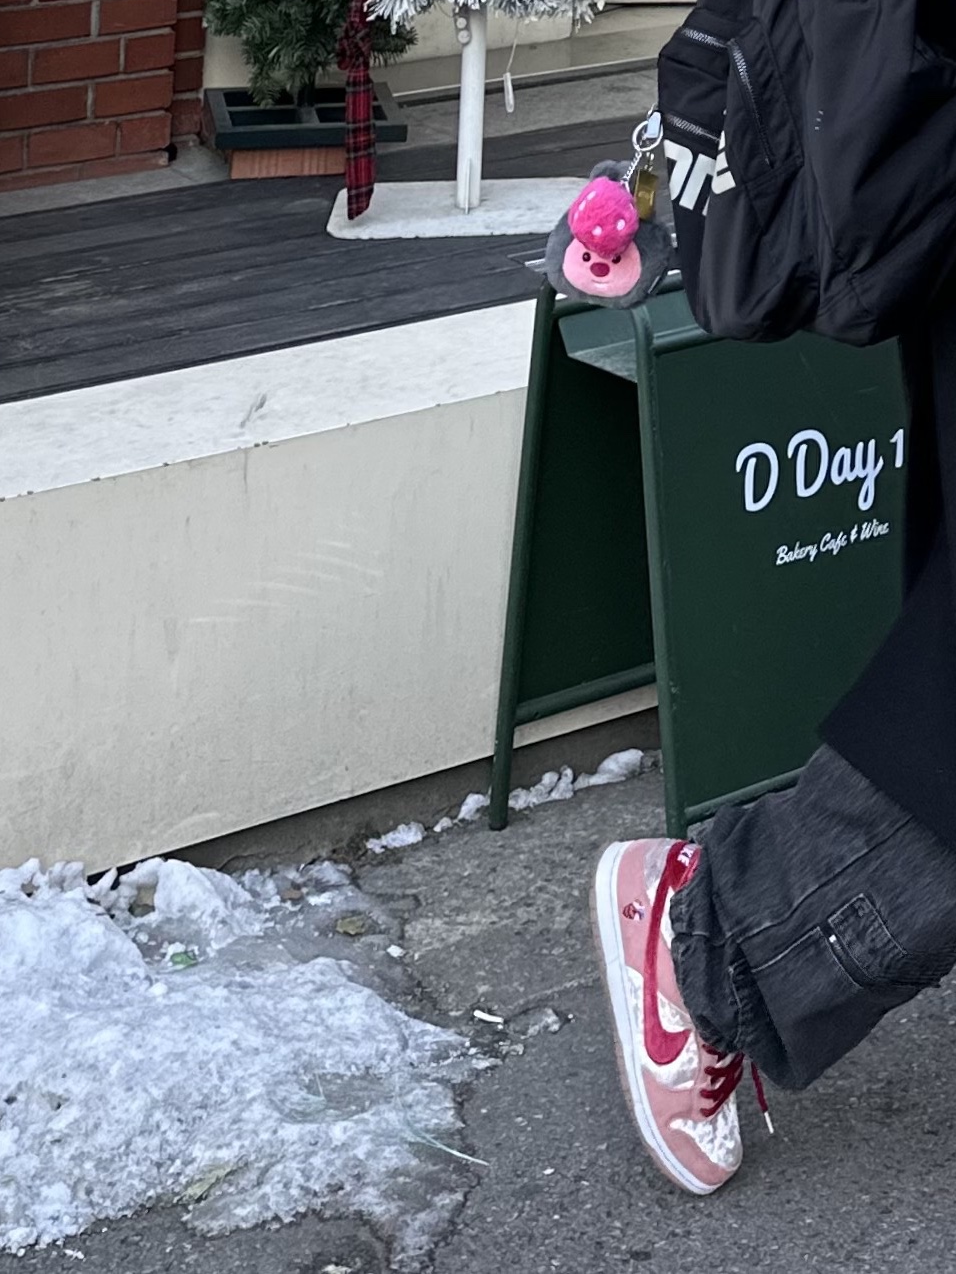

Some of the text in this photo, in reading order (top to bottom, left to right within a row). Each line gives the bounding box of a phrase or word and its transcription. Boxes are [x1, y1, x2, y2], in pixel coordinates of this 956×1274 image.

[736, 428, 904, 511] D Day 1
[776, 541, 818, 566] Bakery
[820, 531, 847, 555] Cafe
[860, 518, 889, 540] Wine
